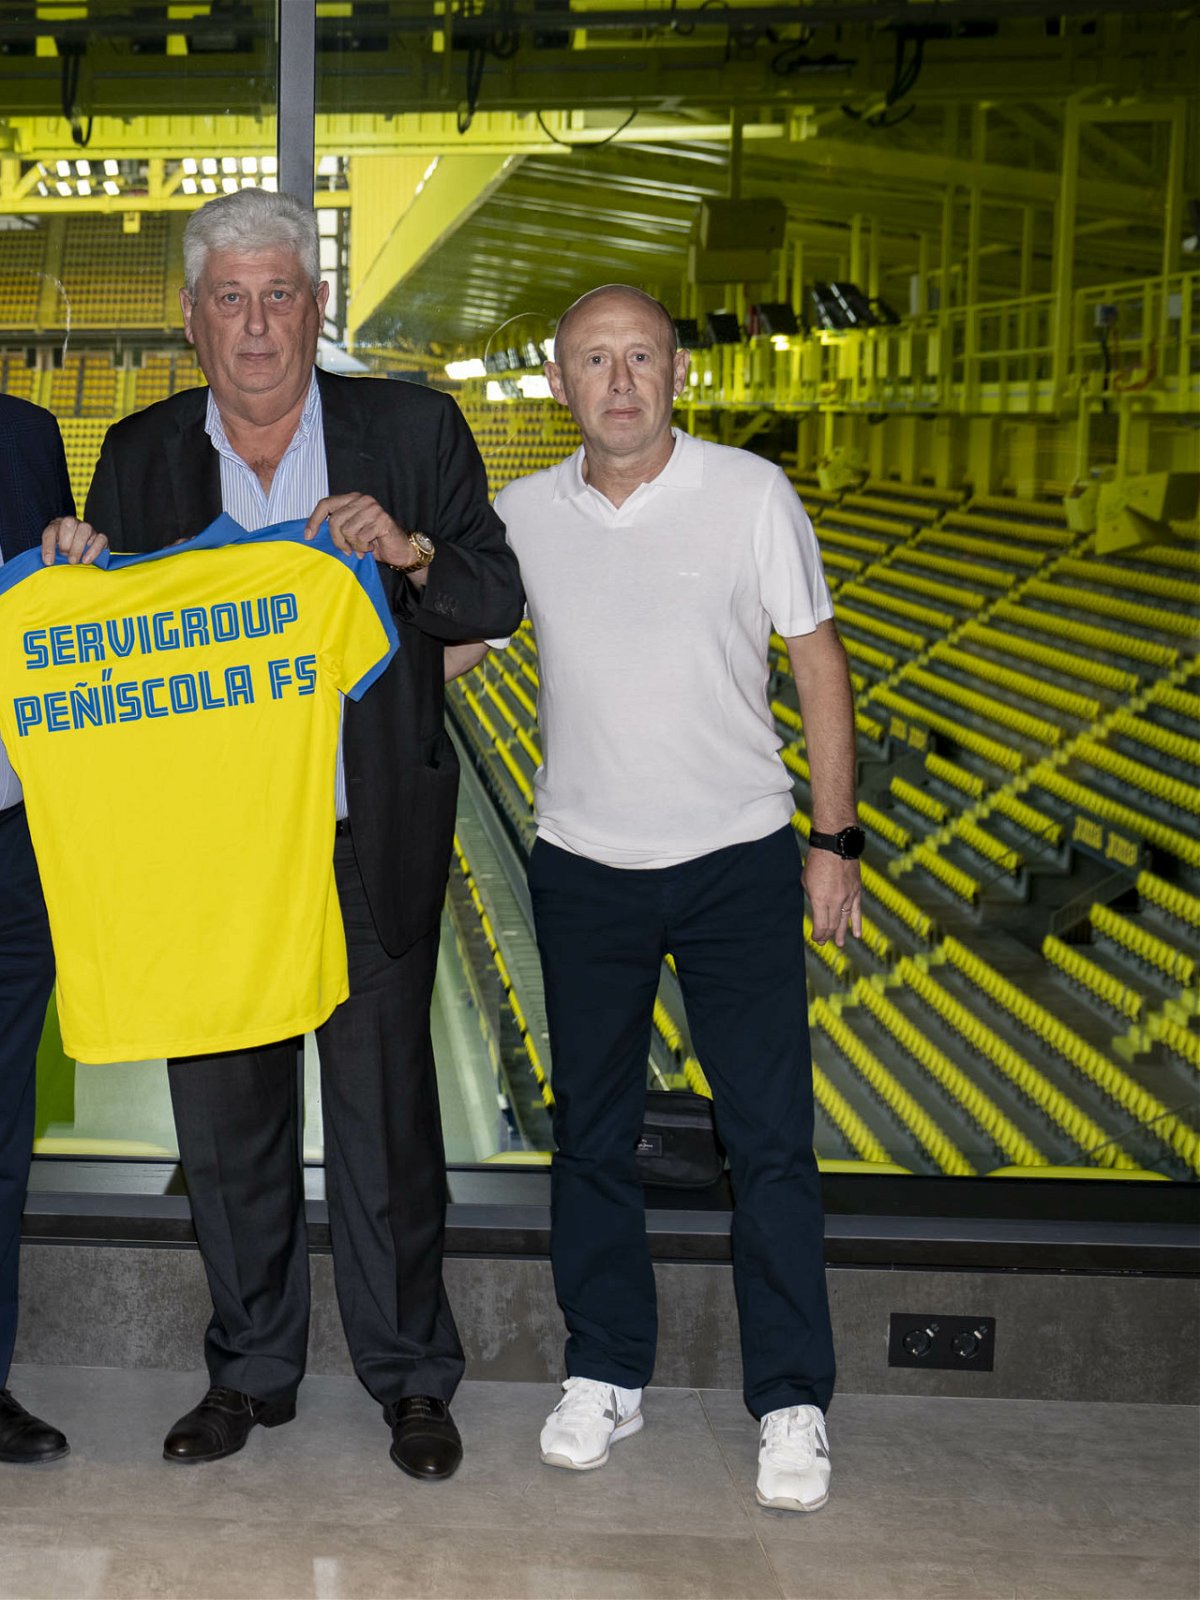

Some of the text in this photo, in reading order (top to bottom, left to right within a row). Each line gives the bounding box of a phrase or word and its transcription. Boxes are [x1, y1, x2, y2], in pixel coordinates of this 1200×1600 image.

[23, 593, 298, 670] SERVIGROUP
[13, 654, 317, 737] PEÑÍSCOLA FS
